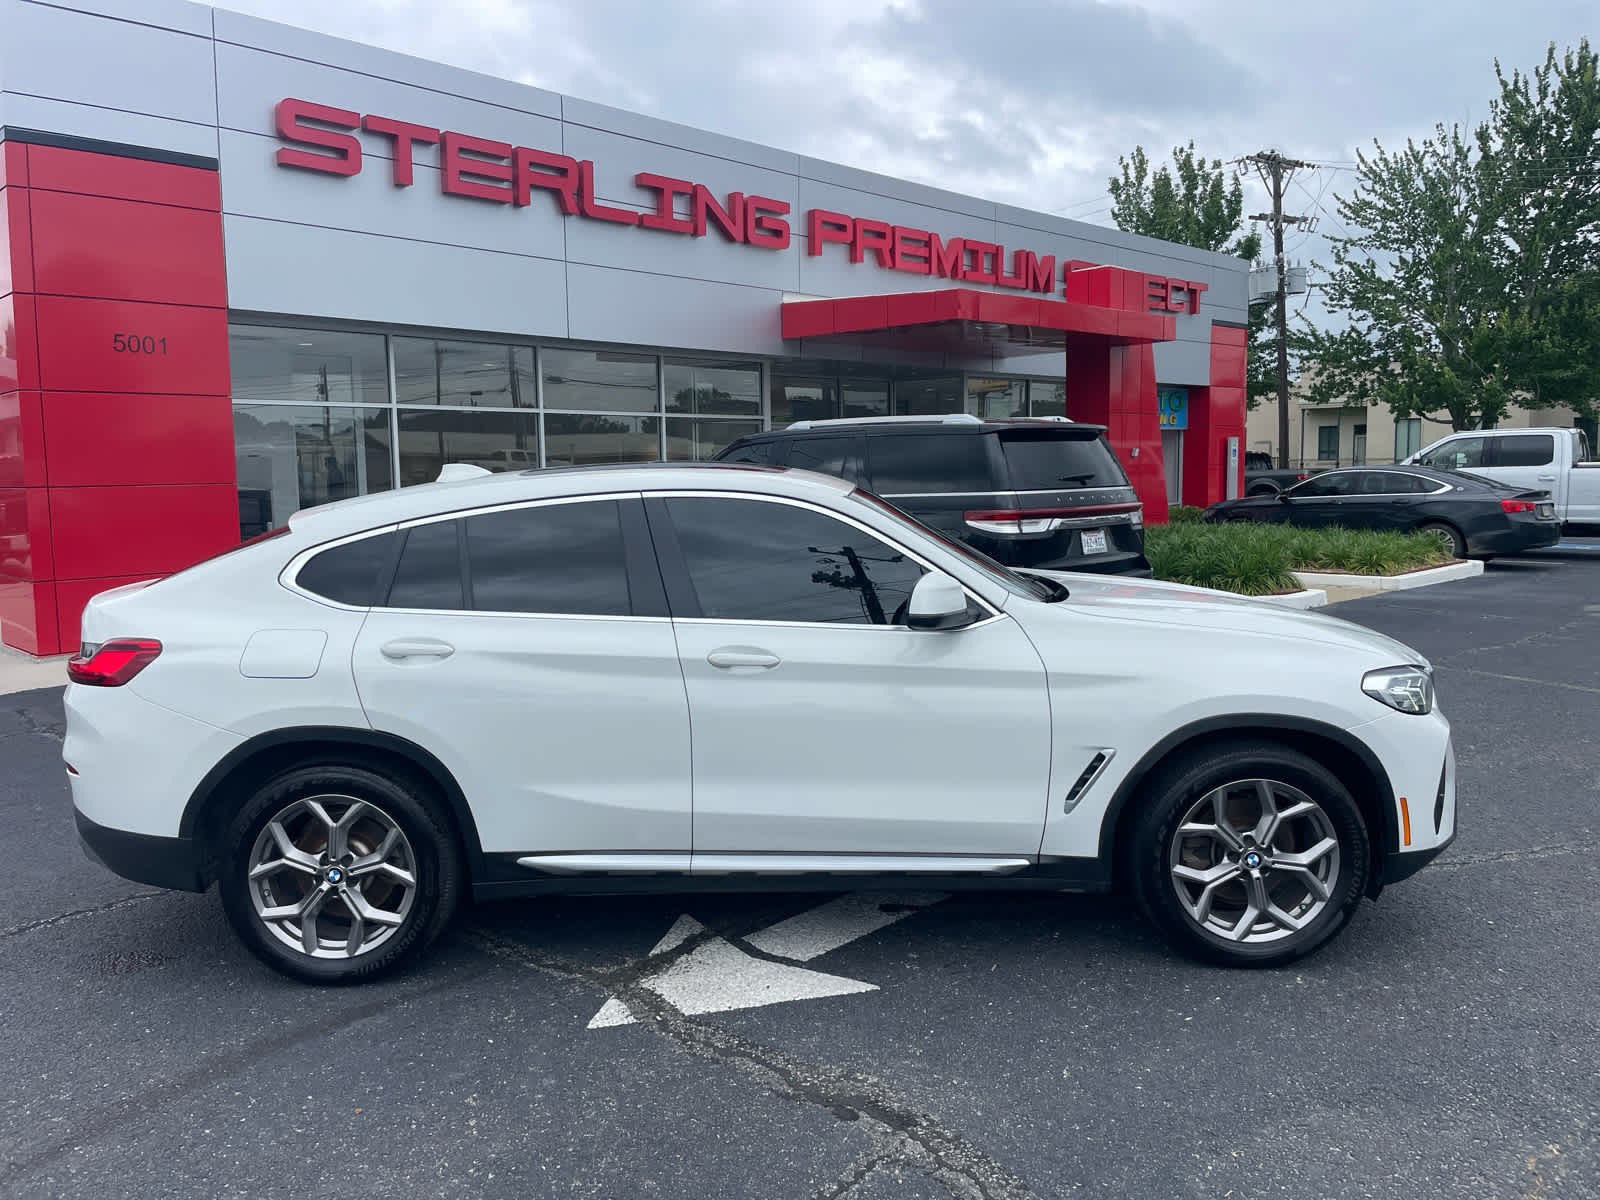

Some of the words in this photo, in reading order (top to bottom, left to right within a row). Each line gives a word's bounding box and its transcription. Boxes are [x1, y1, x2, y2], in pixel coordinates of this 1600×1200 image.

[273, 97, 791, 250] STERLING
[807, 208, 1056, 293] PREMIUM
[112, 333, 167, 355] 5001
